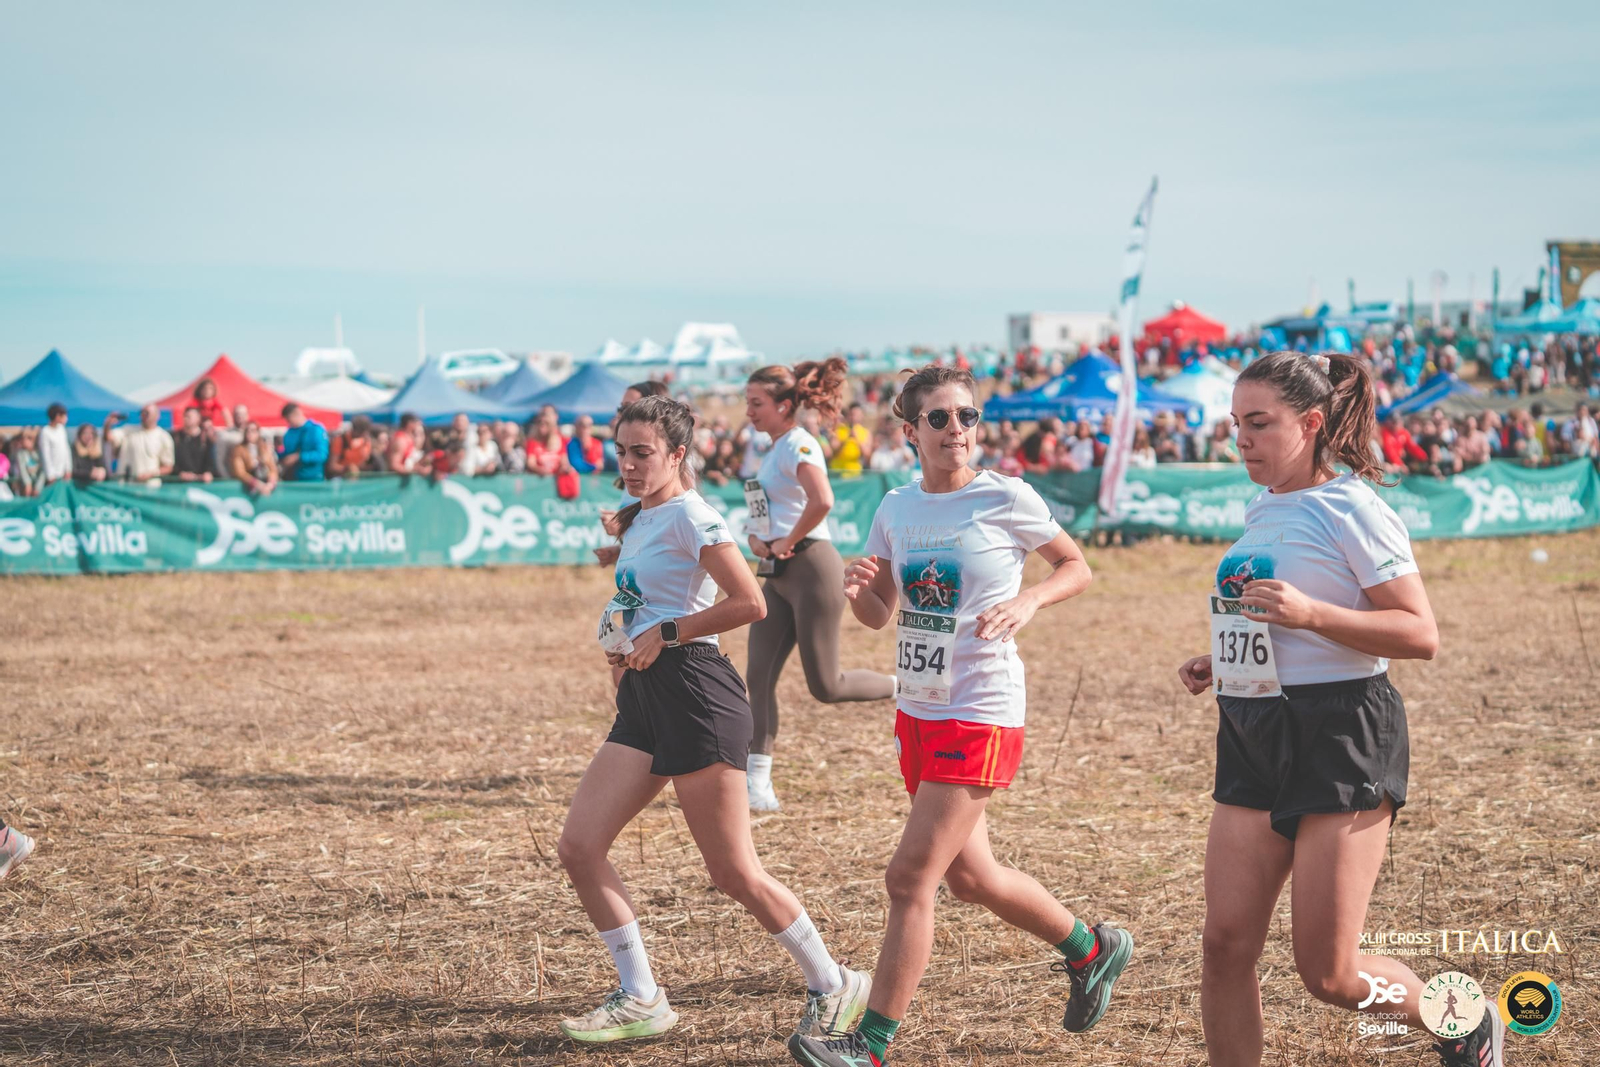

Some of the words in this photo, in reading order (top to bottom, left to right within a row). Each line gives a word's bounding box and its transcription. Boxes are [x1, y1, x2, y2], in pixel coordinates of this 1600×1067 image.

[42, 524, 148, 557] Sevilla
[305, 521, 406, 554] Sevilla
[898, 640, 945, 675] 1554
[1219, 631, 1268, 665] 1376
